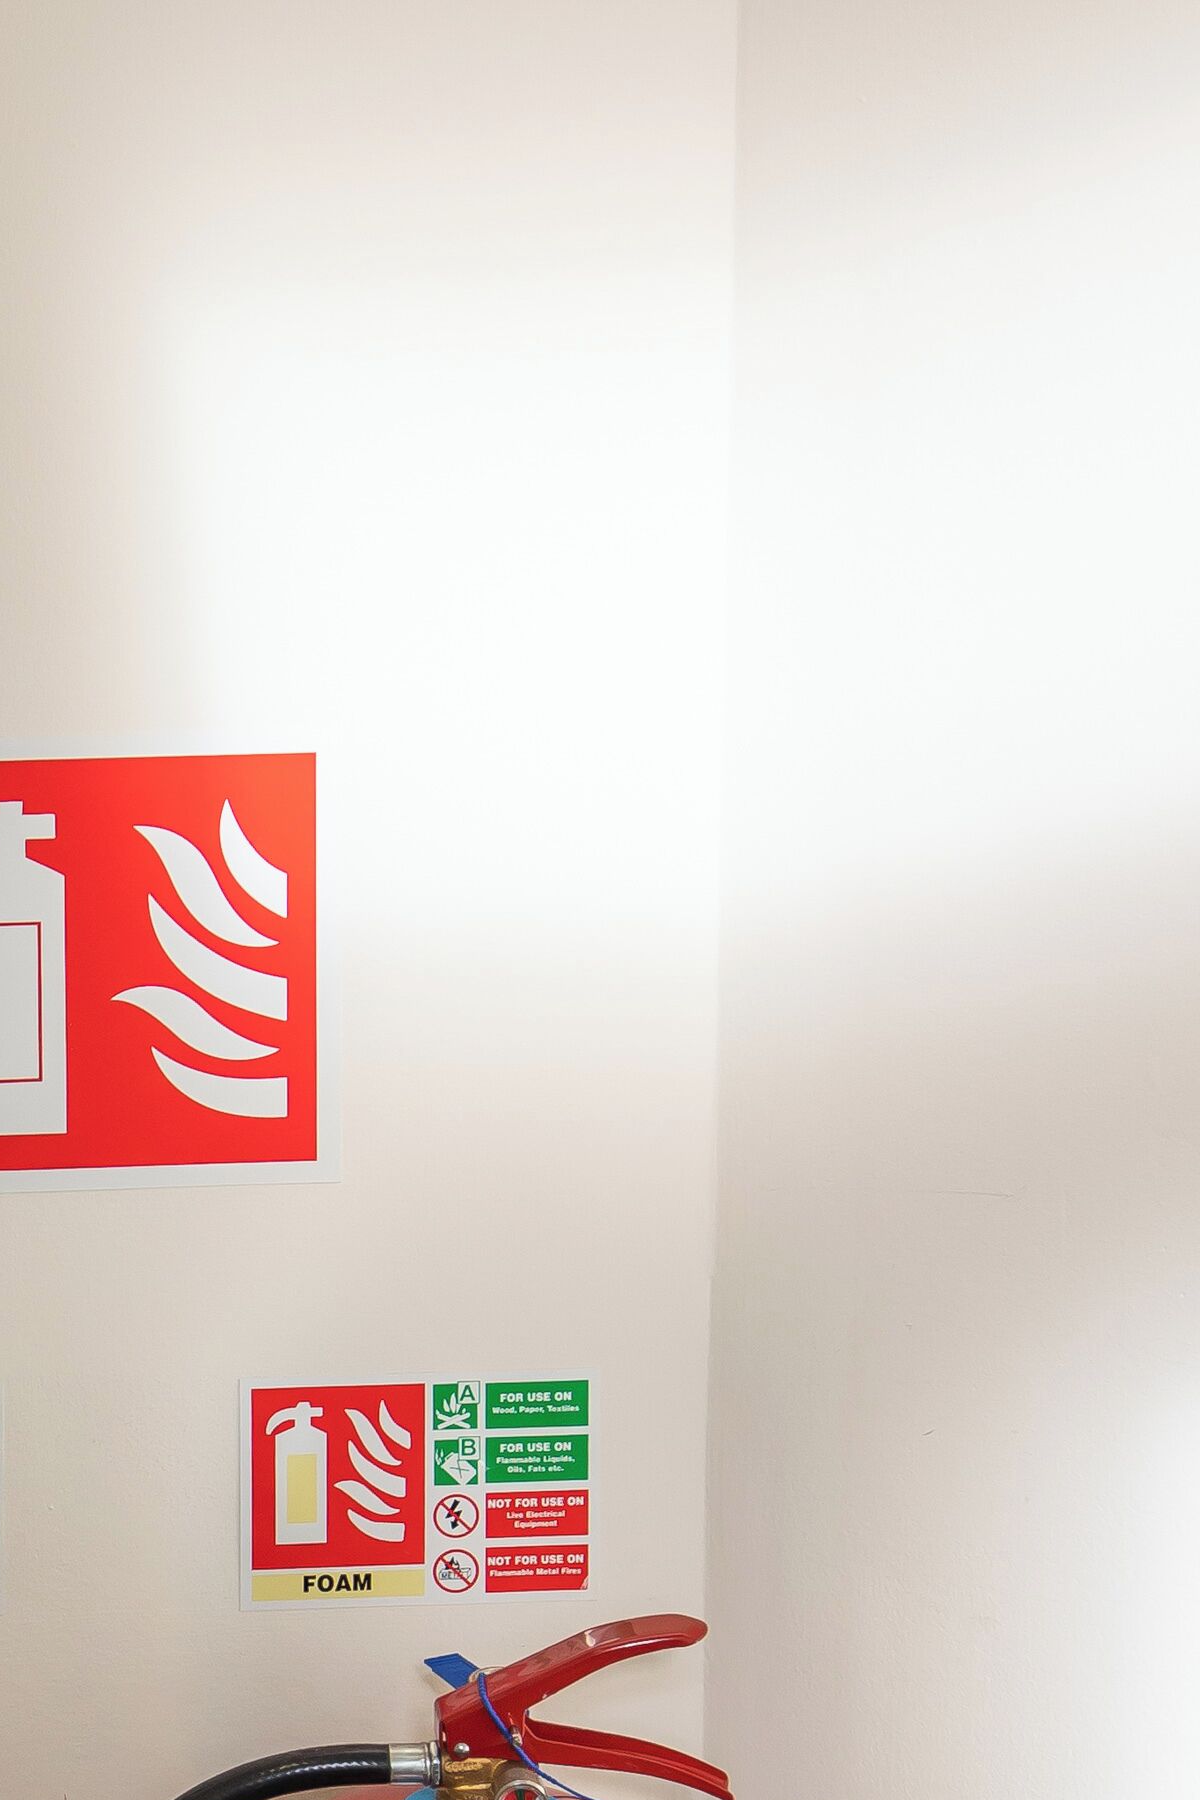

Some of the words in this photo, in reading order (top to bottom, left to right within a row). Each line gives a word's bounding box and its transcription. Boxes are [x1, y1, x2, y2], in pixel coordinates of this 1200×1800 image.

[460, 1385, 475, 1400] A
[500, 1393, 523, 1402] FOR
[527, 1392, 551, 1402] USE
[554, 1391, 572, 1401] ON
[519, 1406, 545, 1414] Paper,
[462, 1439, 476, 1456] B
[500, 1443, 523, 1453] FOR
[527, 1442, 551, 1452] USE
[554, 1441, 572, 1451] ON
[496, 1456, 540, 1464] Flammable
[543, 1455, 575, 1464] Liquids,
[507, 1466, 526, 1474] Oils,
[487, 1499, 512, 1509] NOT
[514, 1498, 538, 1508] FOR
[541, 1497, 564, 1507] USE
[567, 1496, 585, 1506] ON
[506, 1511, 524, 1519] Live
[525, 1510, 566, 1518] Electrical
[513, 1520, 558, 1529] Equipment
[487, 1556, 512, 1566] NOT
[514, 1555, 538, 1565] FOR
[541, 1554, 564, 1564] USE
[566, 1554, 585, 1563] ON
[489, 1569, 534, 1577] Flammable
[561, 1567, 582, 1575] Fires
[302, 1573, 372, 1593] FOAM
